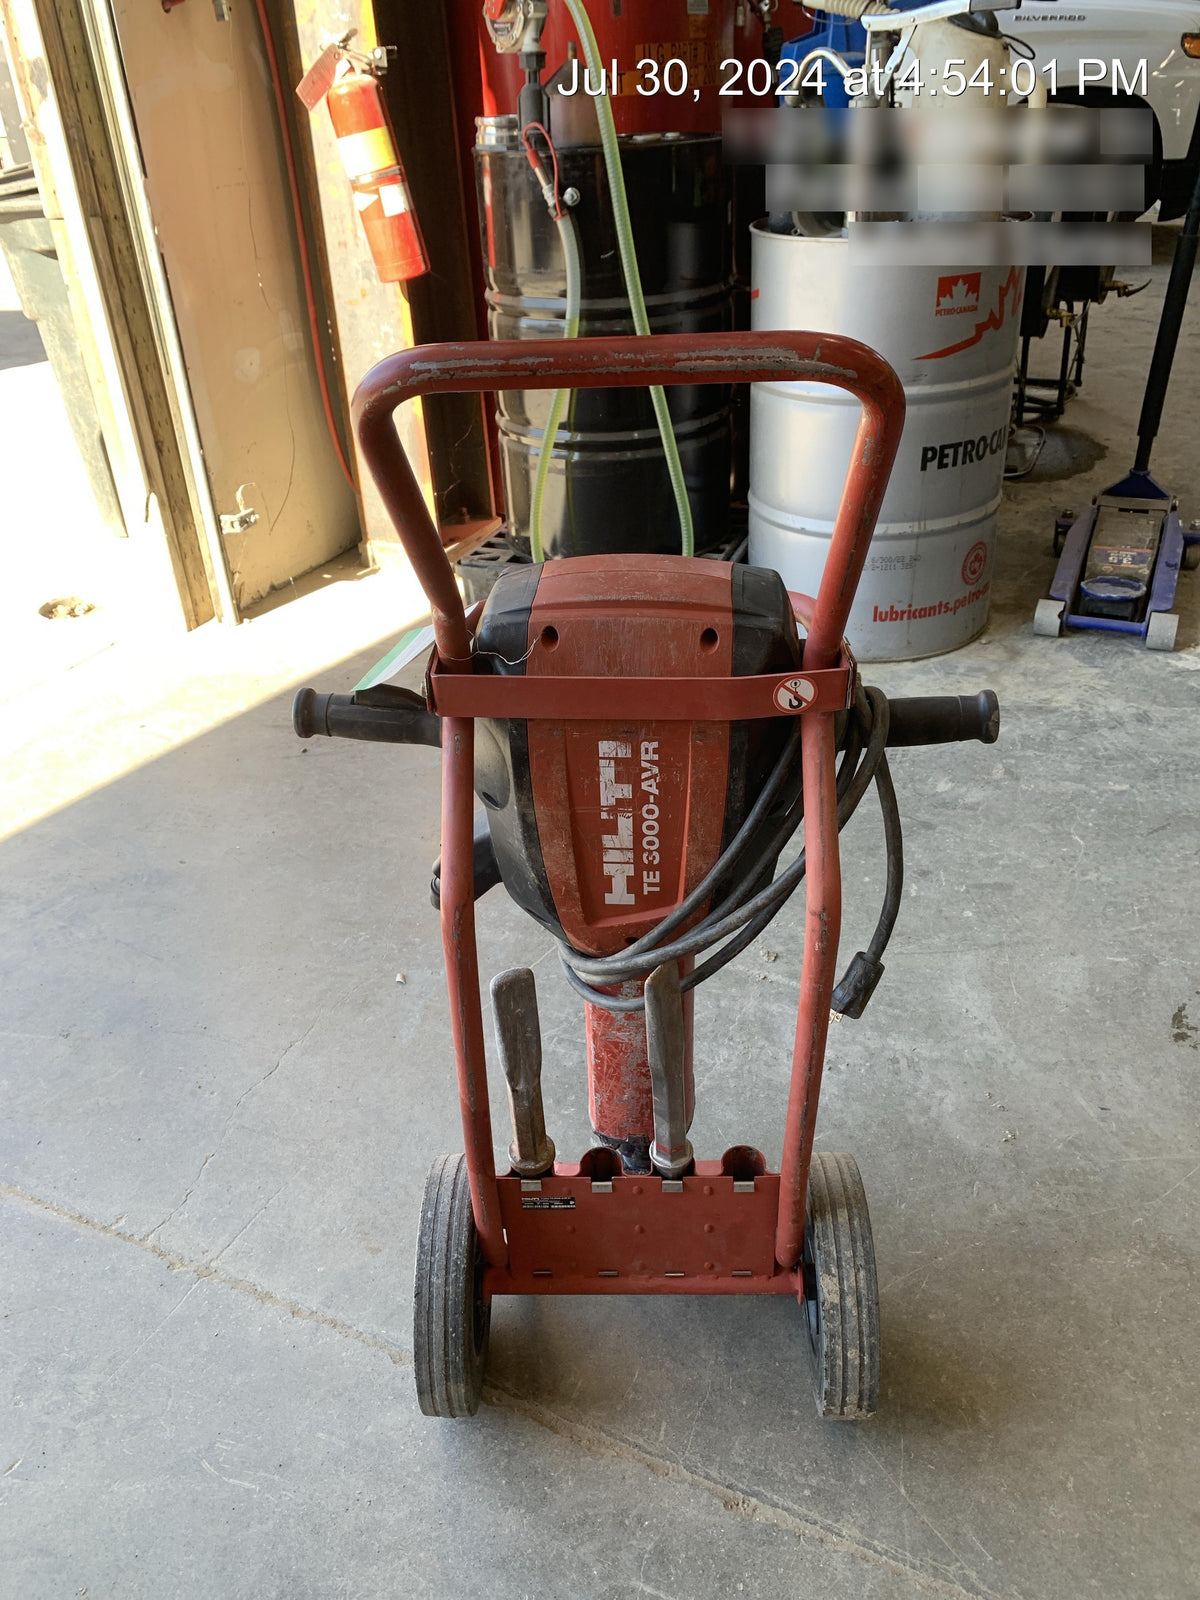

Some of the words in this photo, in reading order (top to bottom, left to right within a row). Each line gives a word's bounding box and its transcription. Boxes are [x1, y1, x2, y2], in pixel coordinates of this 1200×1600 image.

[1014, 14, 1087, 22] SILVERADO
[598, 740, 636, 905] HILTI
[641, 741, 660, 865] 3000-AVR
[643, 870, 661, 895] TE
